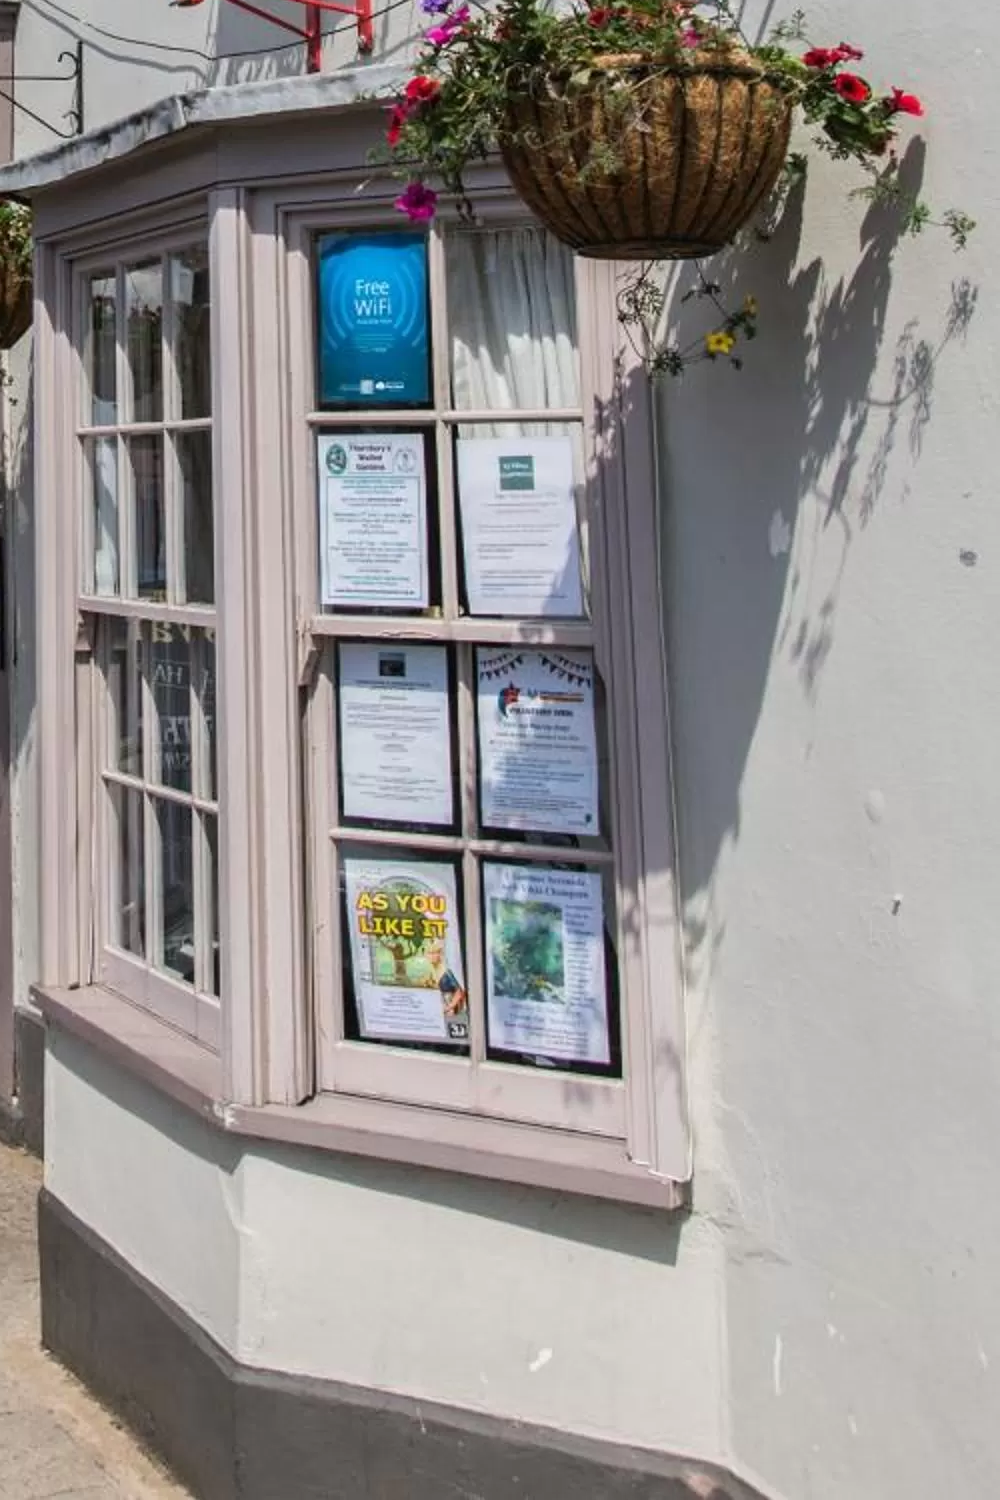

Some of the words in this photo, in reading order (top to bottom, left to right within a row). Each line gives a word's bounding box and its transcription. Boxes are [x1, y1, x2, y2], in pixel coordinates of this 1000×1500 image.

[354, 279, 391, 297] Free
[353, 297, 392, 316] WiFi
[356, 891, 389, 912] AS
[394, 892, 448, 914] YOU
[359, 914, 415, 937] LIKE
[420, 917, 449, 939] IT
